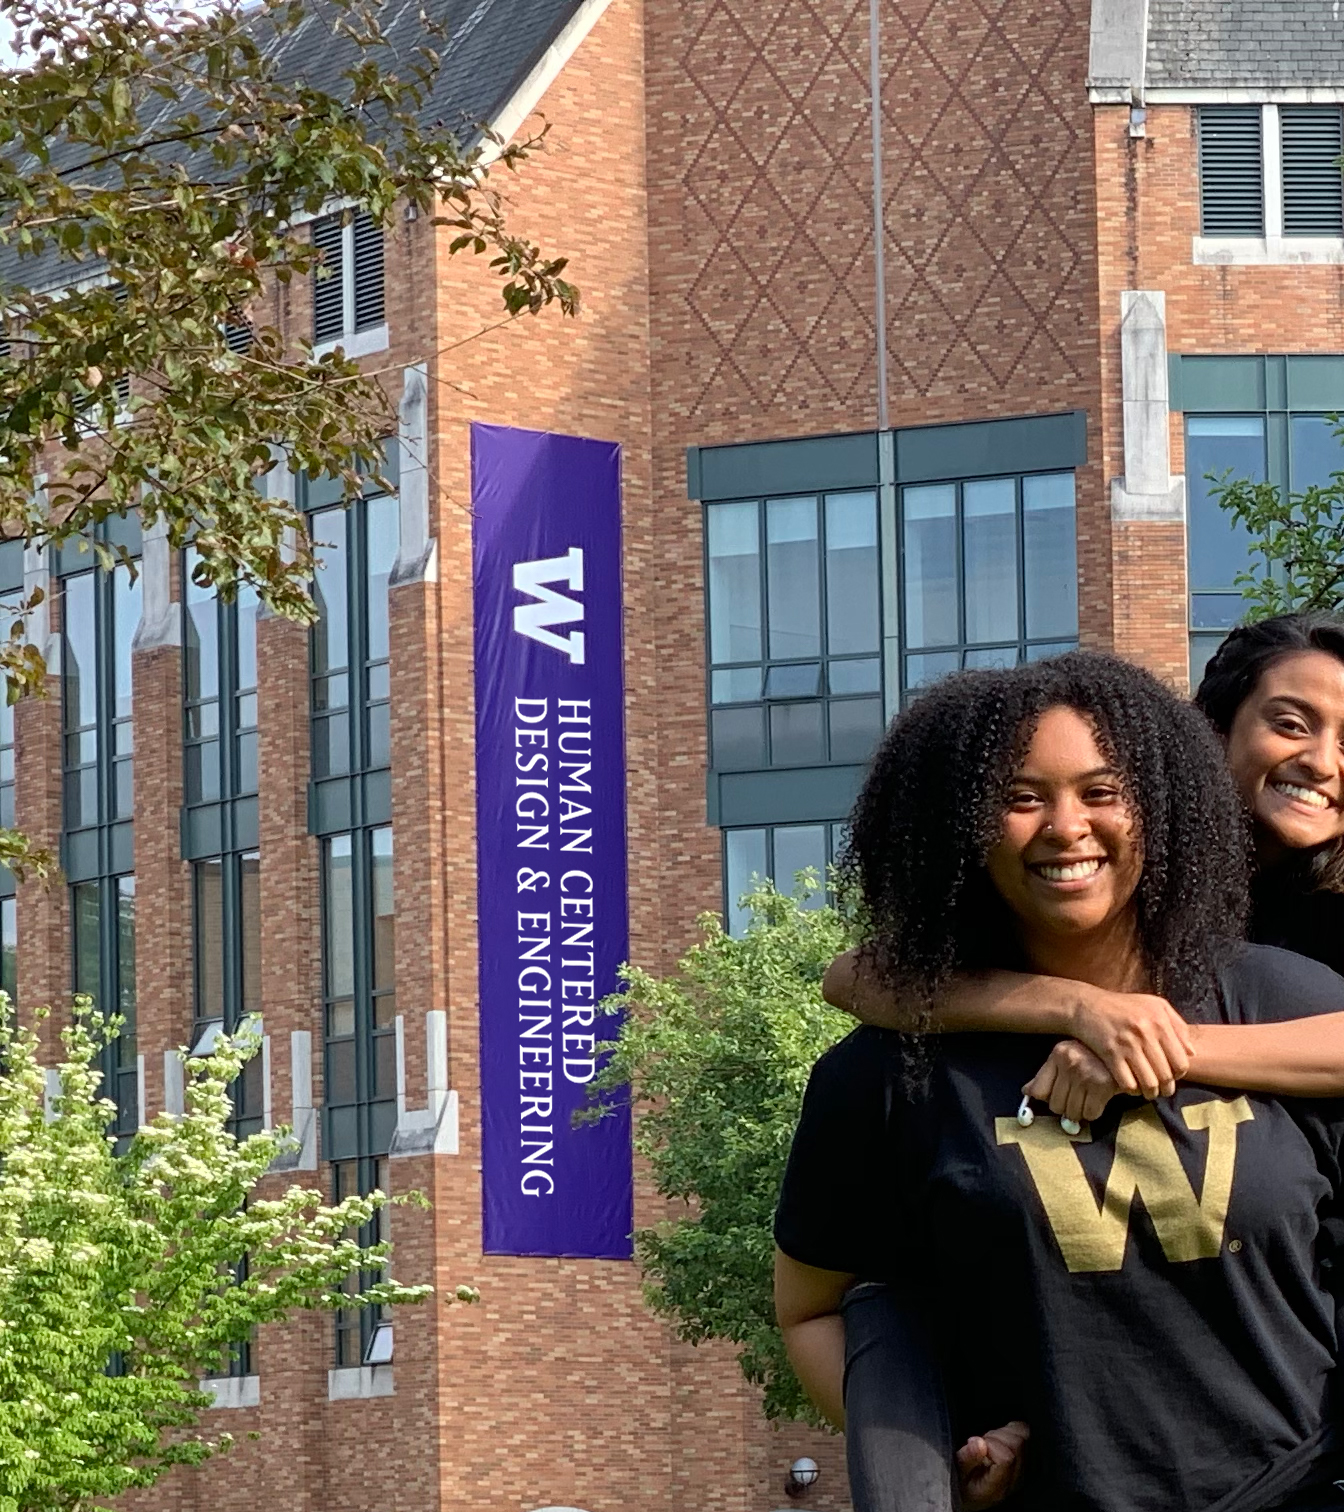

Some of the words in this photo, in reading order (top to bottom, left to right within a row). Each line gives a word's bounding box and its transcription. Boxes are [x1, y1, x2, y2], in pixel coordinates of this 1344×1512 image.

[513, 547, 585, 664] W
[515, 697, 549, 850] DESIGN
[558, 698, 593, 855] HUMAN
[517, 867, 550, 893] &
[518, 911, 554, 1197] ENGINEERING
[560, 870, 596, 1084] CENTERED
[994, 1095, 1254, 1273] W
